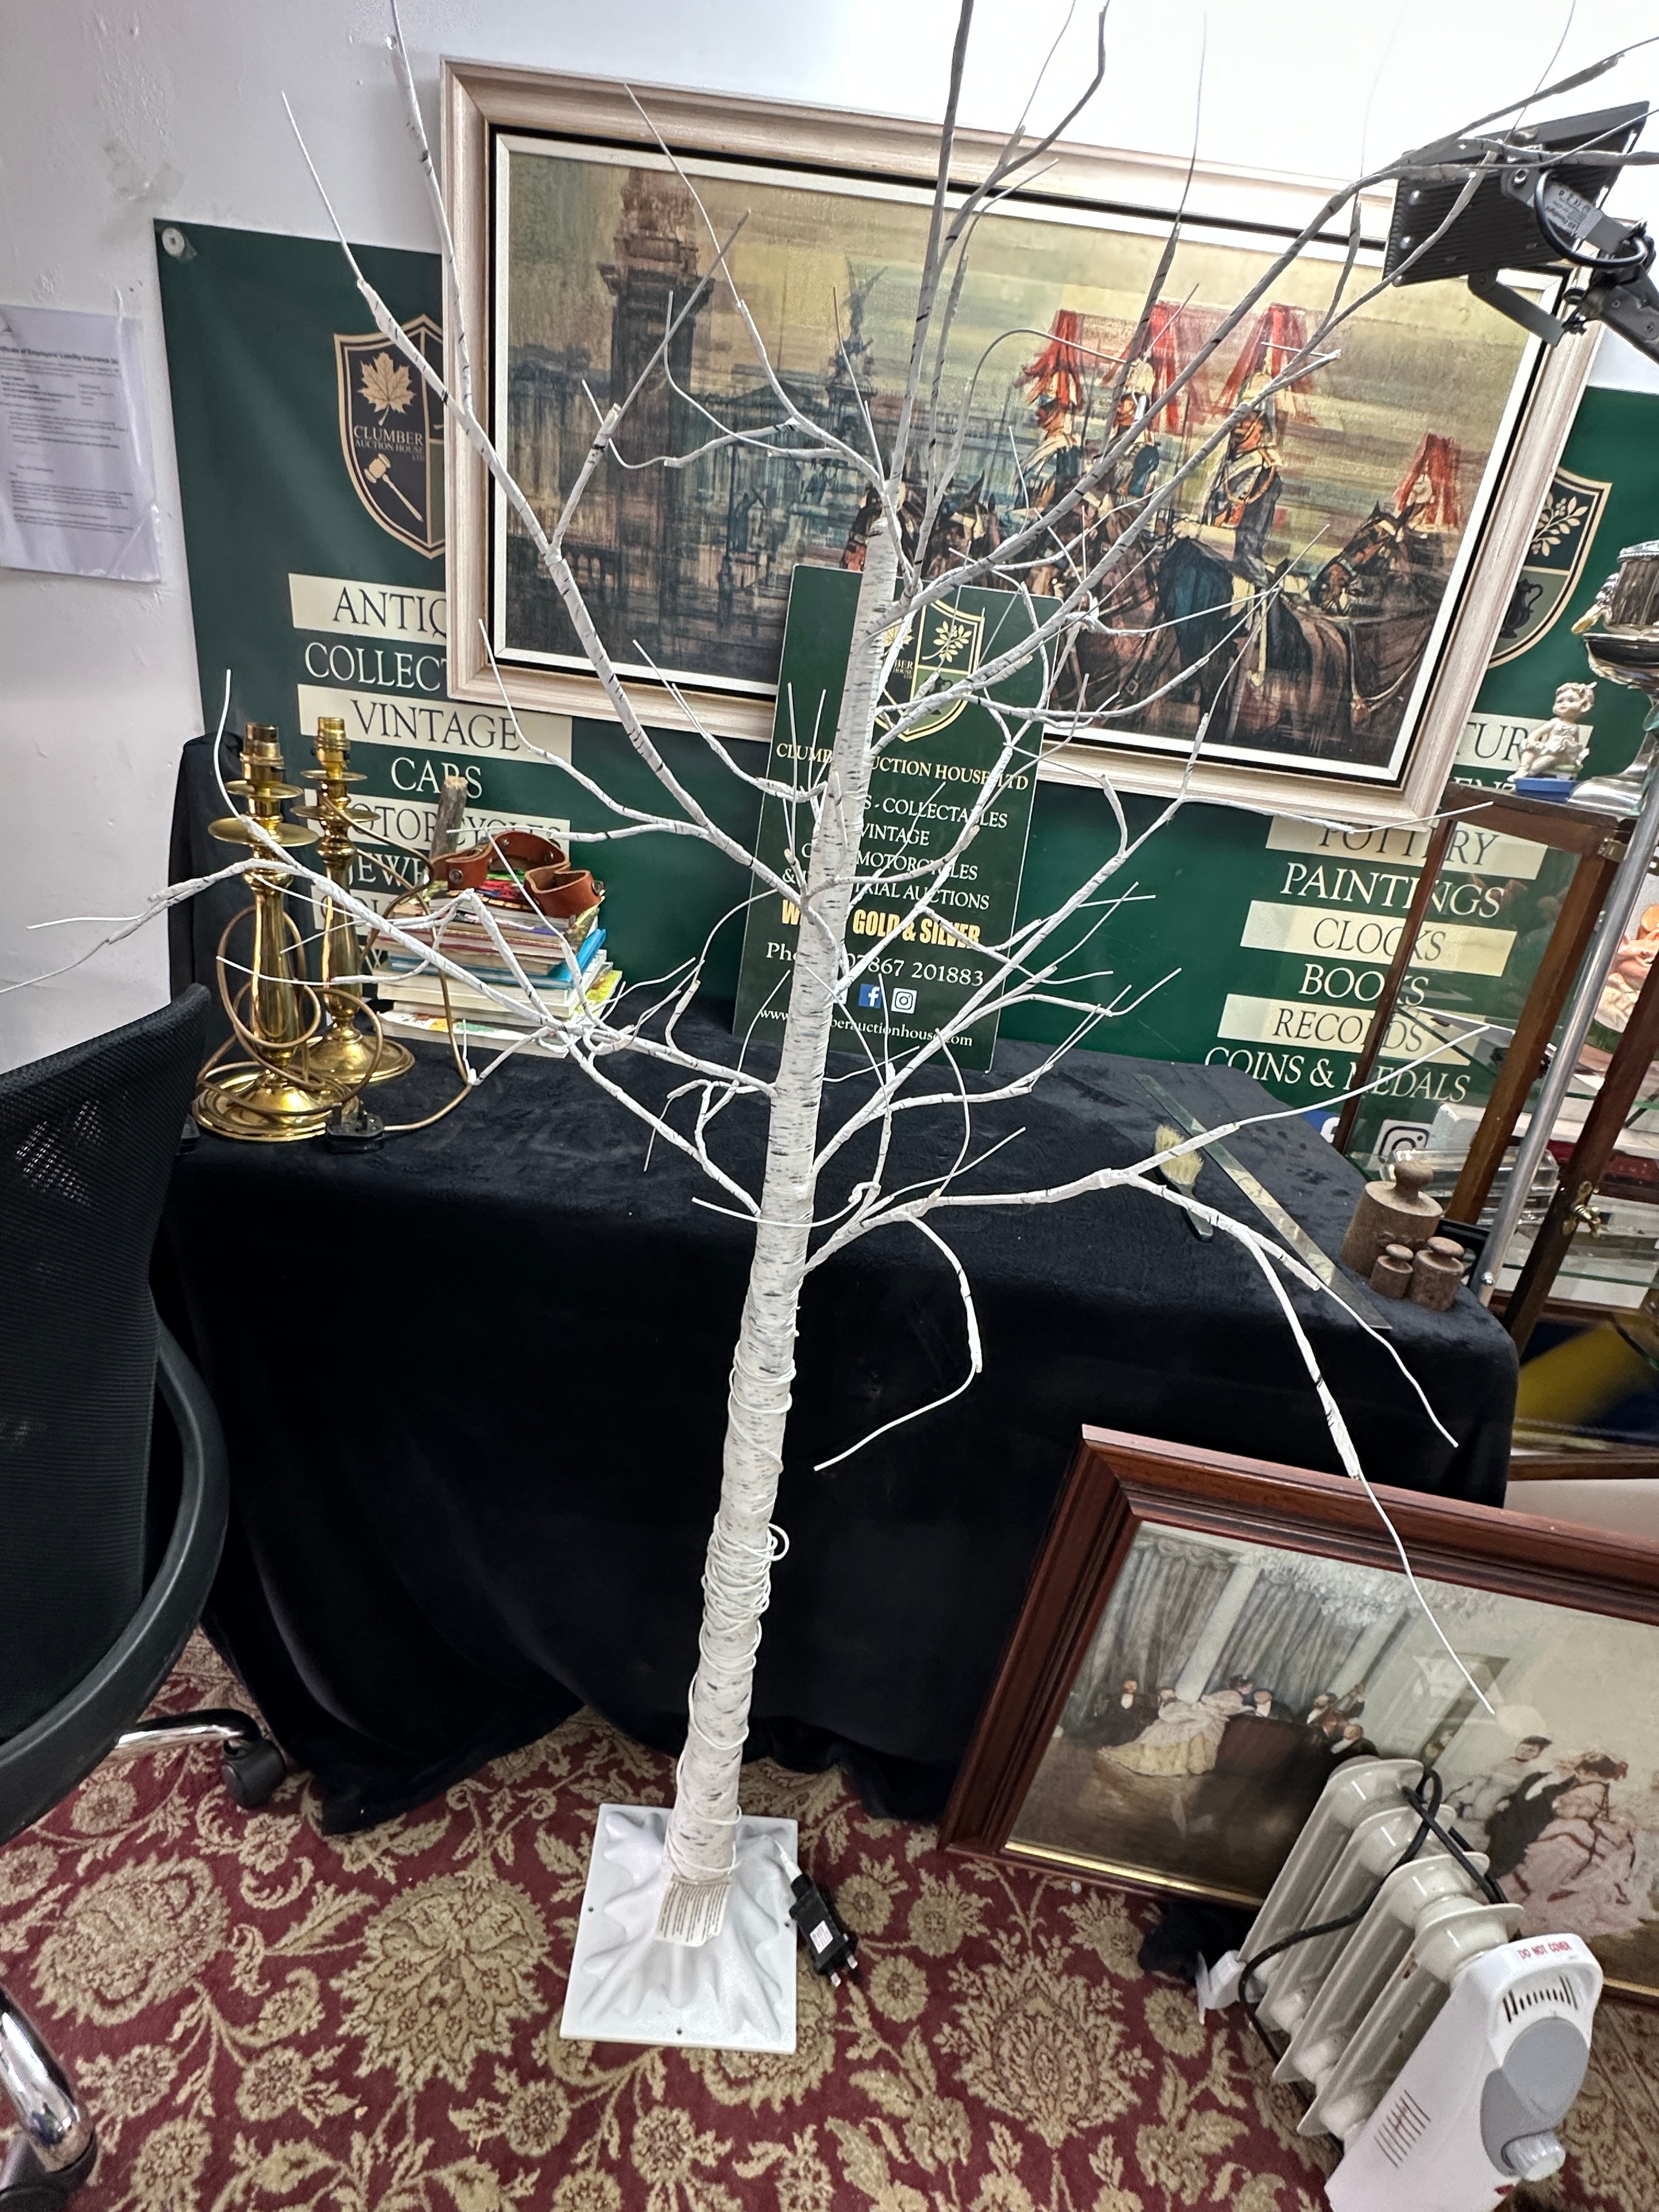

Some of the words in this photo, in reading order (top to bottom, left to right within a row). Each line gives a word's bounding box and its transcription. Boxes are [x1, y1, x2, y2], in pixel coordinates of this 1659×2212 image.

[354, 425, 424, 446] CLUMBER
[332, 586, 446, 640] ANTIQ
[305, 641, 446, 691] COLLEC
[350, 699, 520, 752] VINTAGE
[776, 743, 832, 763] CLUMB
[872, 756, 932, 778] UCTION
[935, 764, 990, 785] HOUSE
[883, 797, 1008, 829] COLLECTALES
[1280, 862, 1505, 919] PAINTINGS
[852, 909, 901, 937] GOLD
[902, 921, 916, 942] &
[1313, 917, 1446, 961] CLOCKS
[911, 962, 984, 987] 201883
[1272, 1008, 1423, 1052] RECODS
[1309, 1058, 1335, 1088] &
